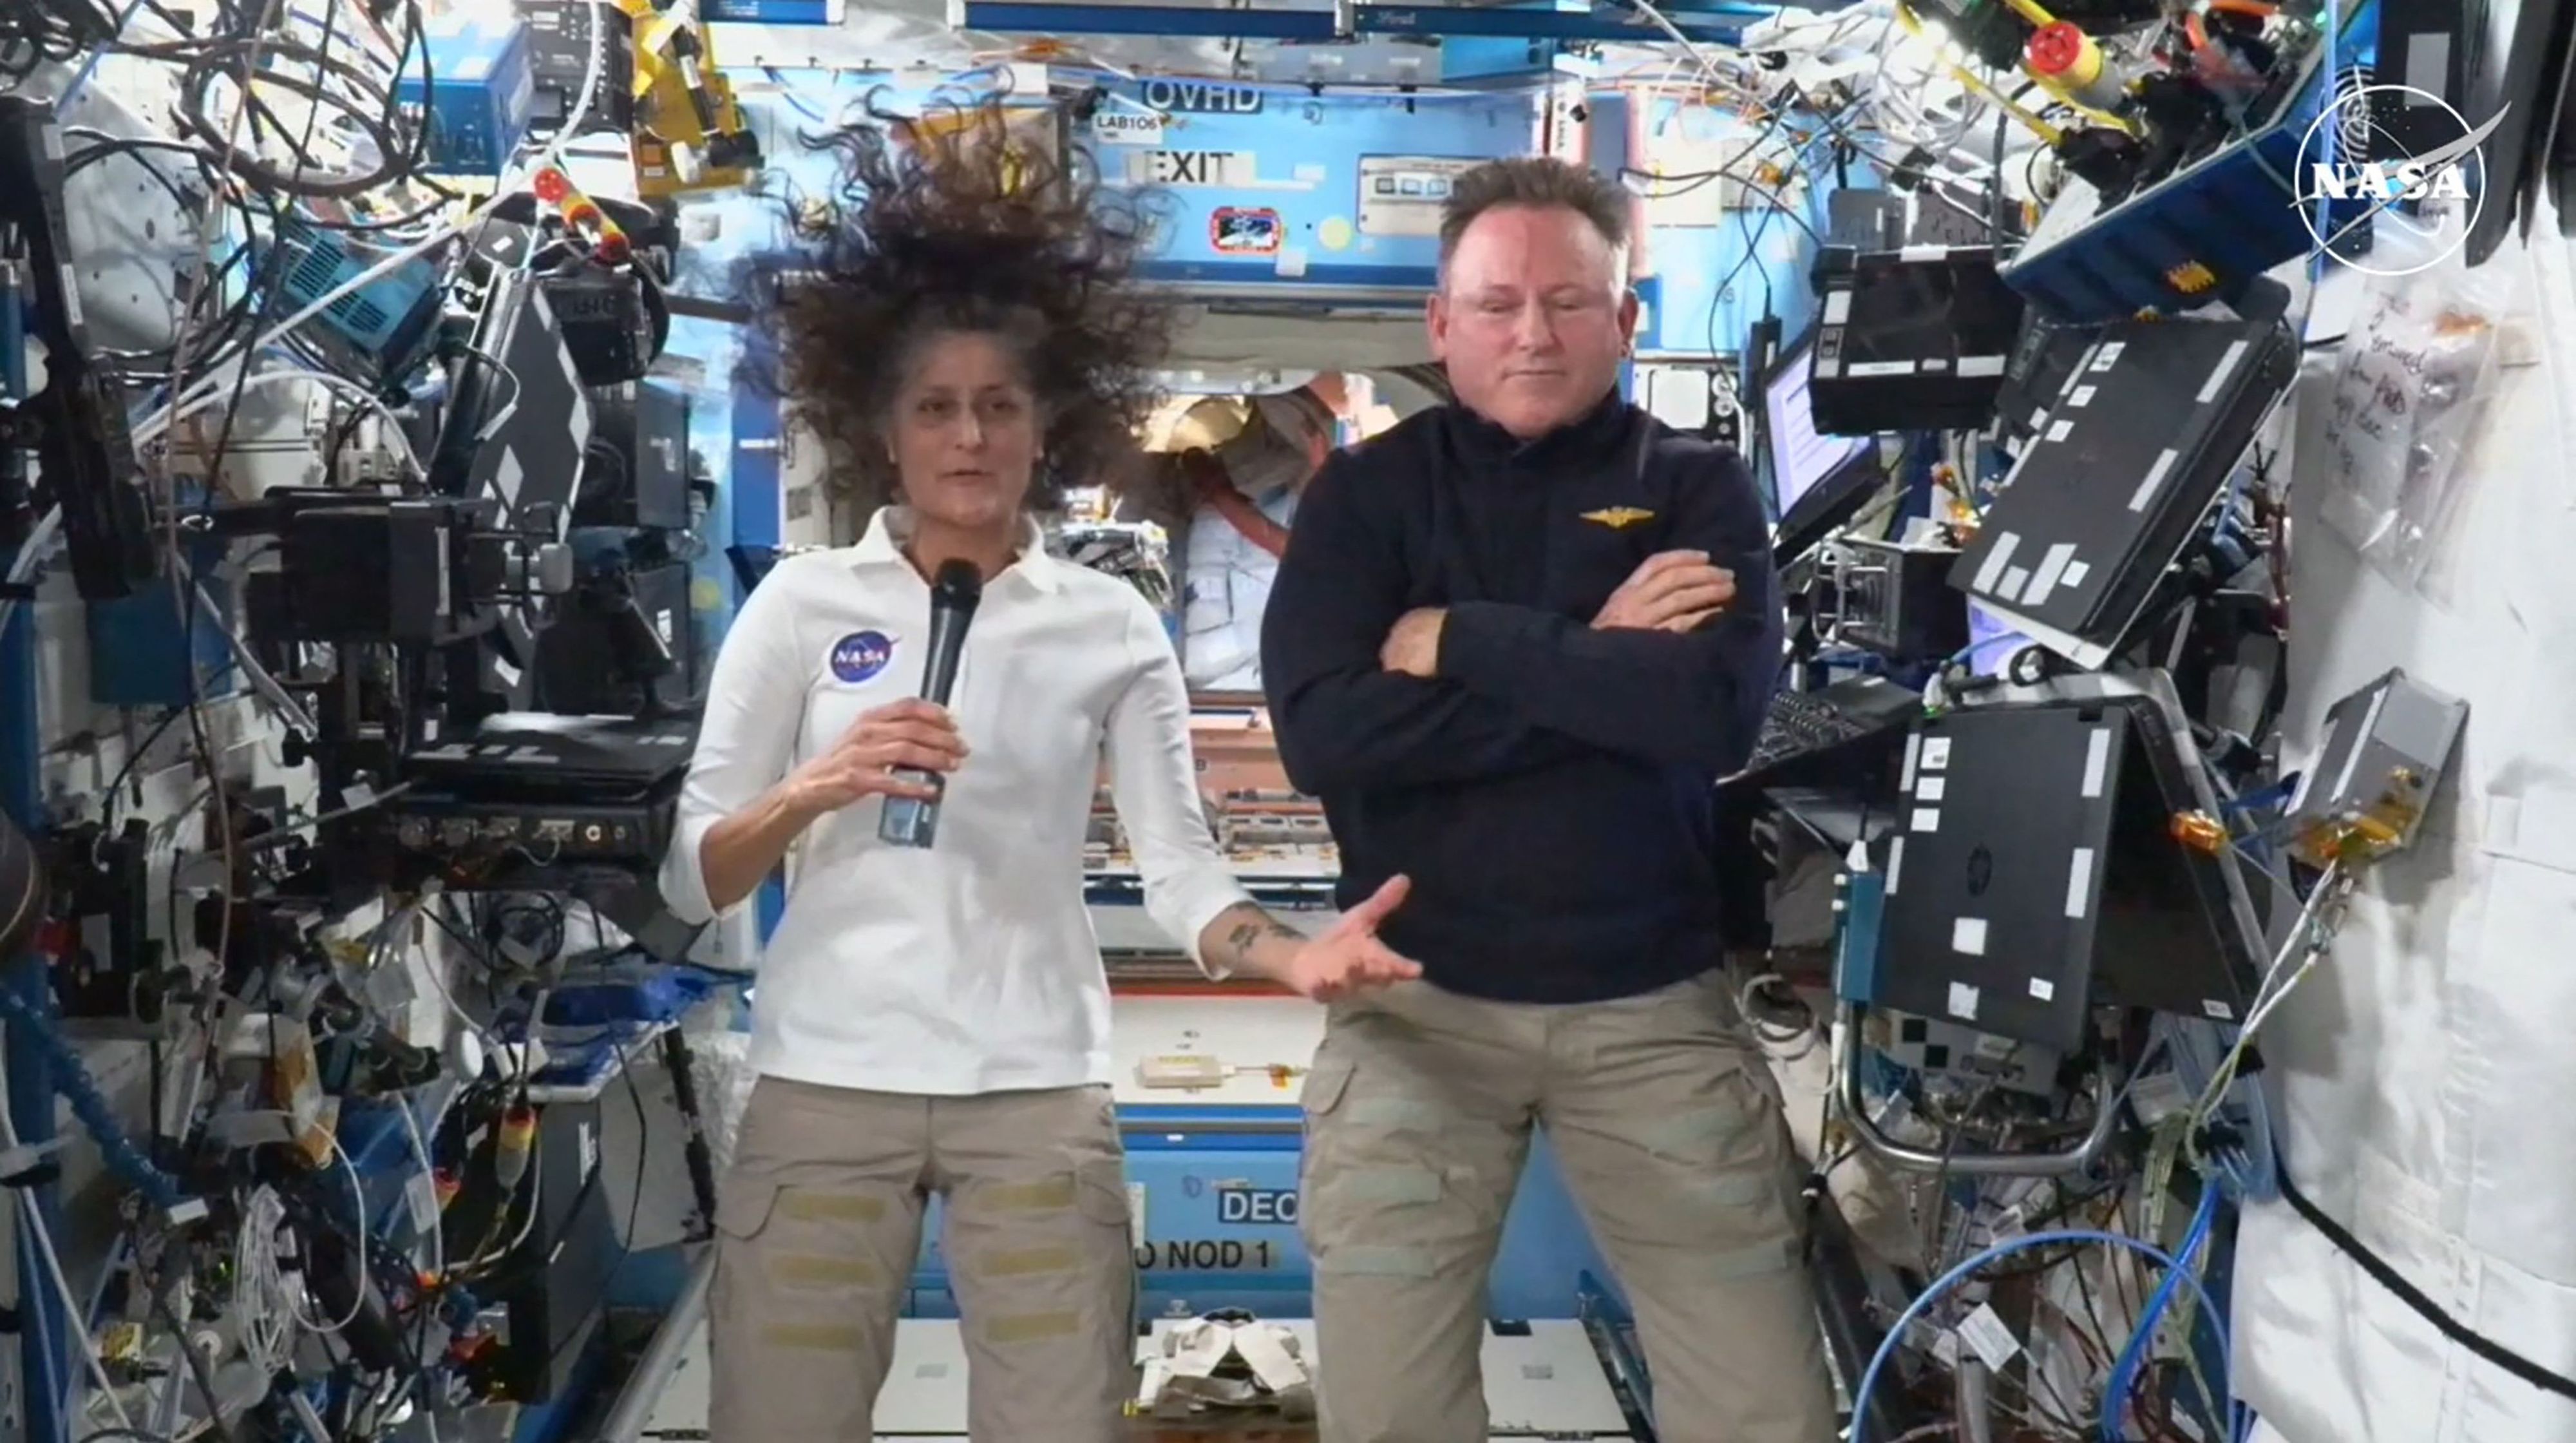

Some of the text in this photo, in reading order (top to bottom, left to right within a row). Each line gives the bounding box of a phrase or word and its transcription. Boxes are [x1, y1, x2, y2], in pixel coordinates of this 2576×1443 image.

[1146, 81, 1260, 111] OVHD
[1146, 150, 1234, 183] EXIT
[835, 649, 885, 665] NASA
[1168, 1239, 1243, 1269] NOD
[1256, 1240, 1267, 1268] 1
